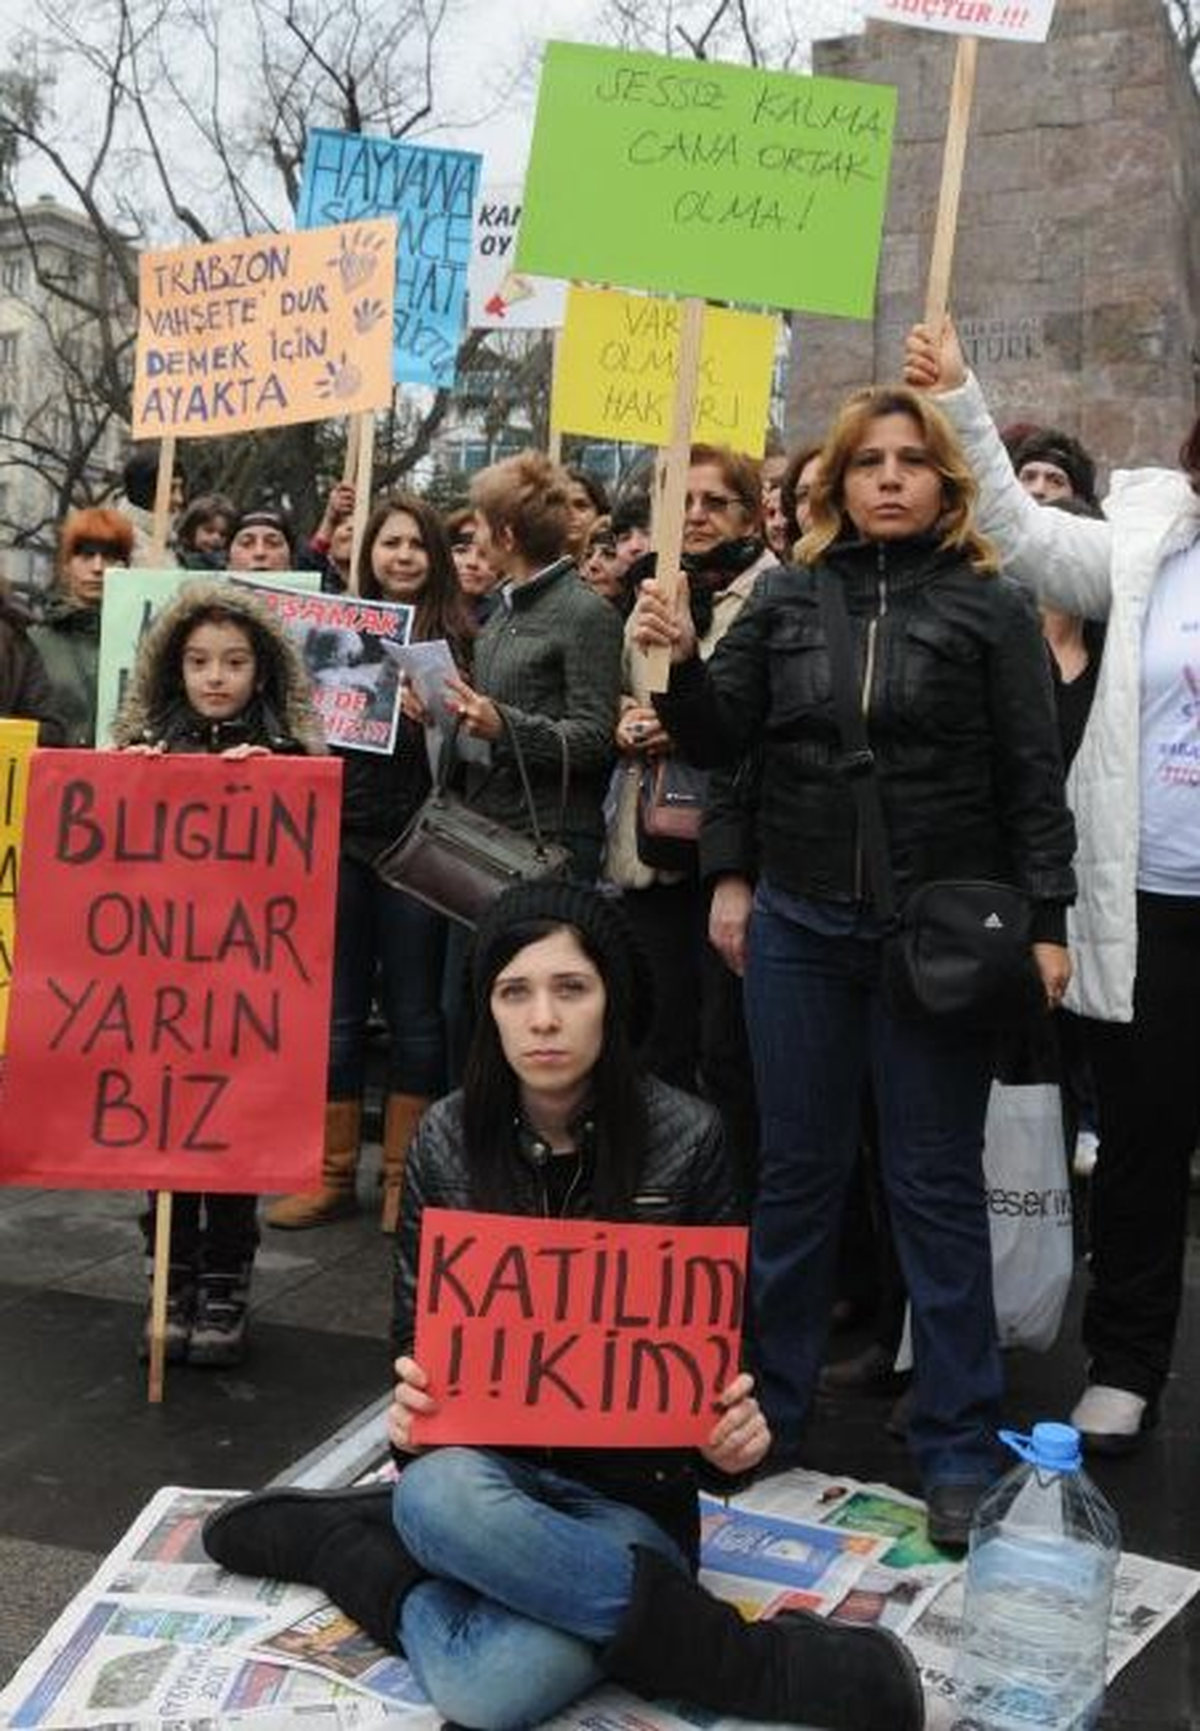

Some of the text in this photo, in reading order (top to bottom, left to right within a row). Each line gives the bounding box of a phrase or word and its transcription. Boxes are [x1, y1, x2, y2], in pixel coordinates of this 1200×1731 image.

[752, 85, 887, 139] KALMA
[306, 136, 476, 214] HAYVANA
[627, 130, 878, 186] CANA ORTAK
[153, 246, 291, 298] TRABZON
[281, 284, 330, 317] DUR
[147, 340, 250, 378] DEMEK
[141, 371, 288, 425] AYAKTA
[55, 780, 318, 874] BUGÜN
[87, 892, 312, 984] ONLAR
[47, 976, 283, 1057] YARIN
[91, 1065, 231, 1153] BİZ
